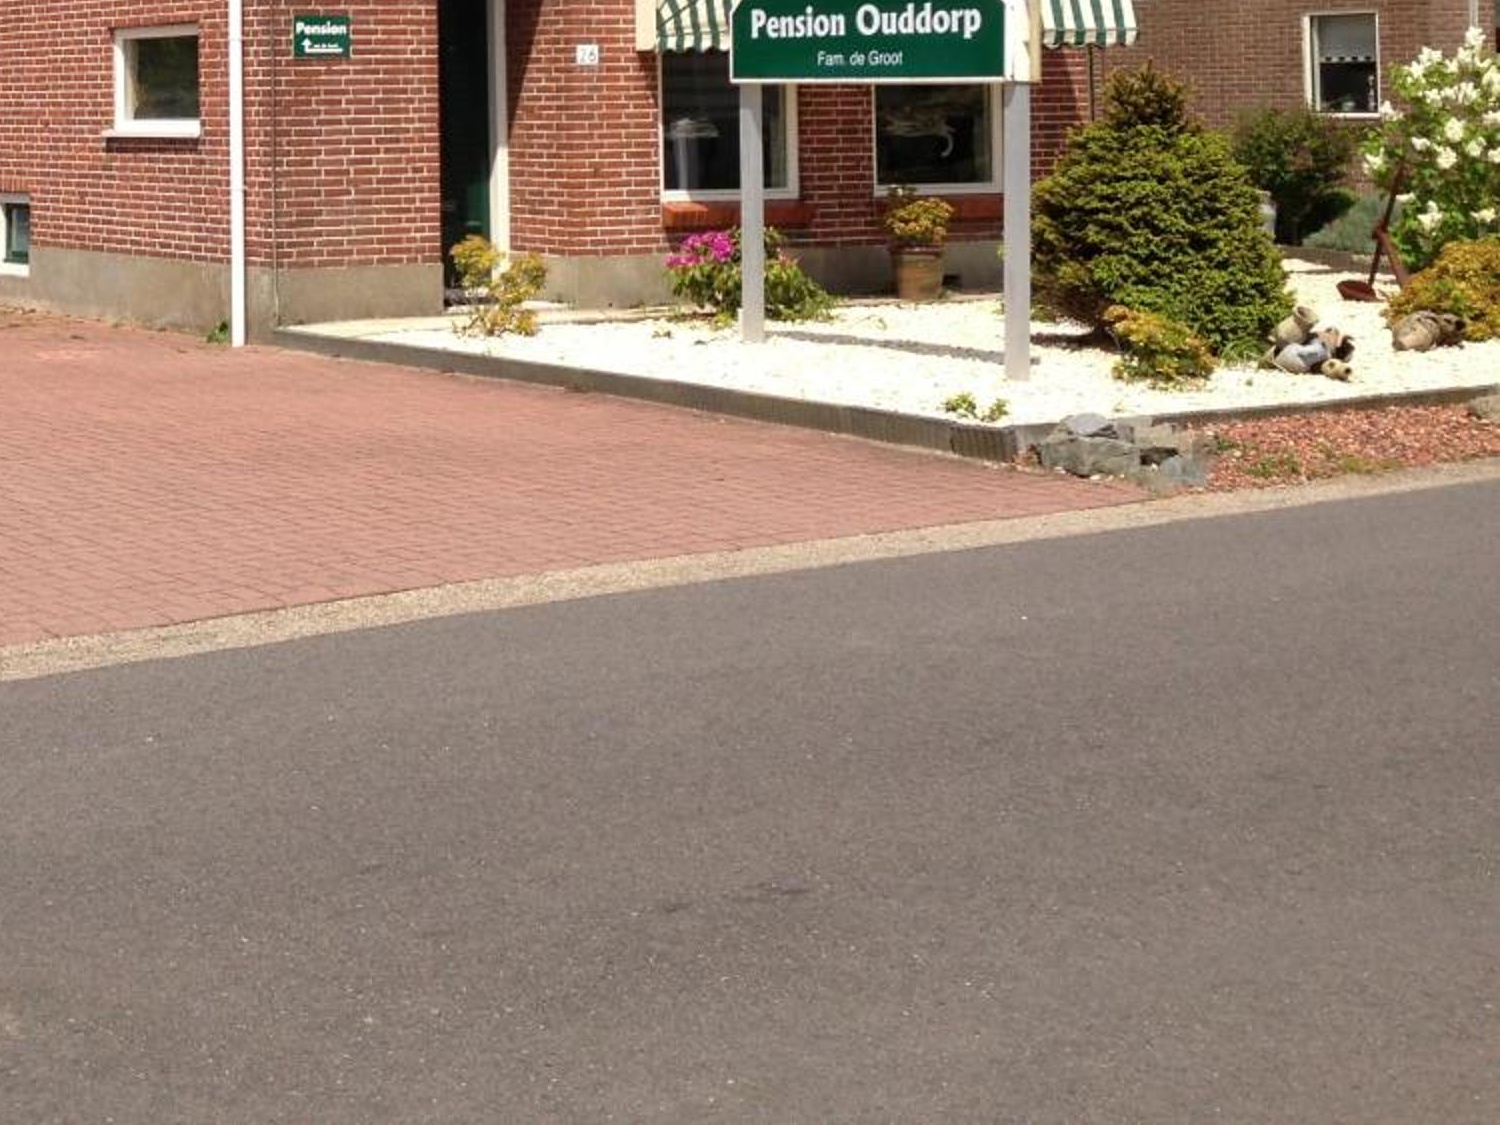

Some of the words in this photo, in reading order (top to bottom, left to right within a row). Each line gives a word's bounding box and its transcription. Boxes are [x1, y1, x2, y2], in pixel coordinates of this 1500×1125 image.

[296, 21, 347, 35] Pension
[750, 5, 846, 39] Pension
[855, 2, 982, 39] Ouddorp
[849, 50, 866, 66] de
[867, 49, 904, 66] Groot
